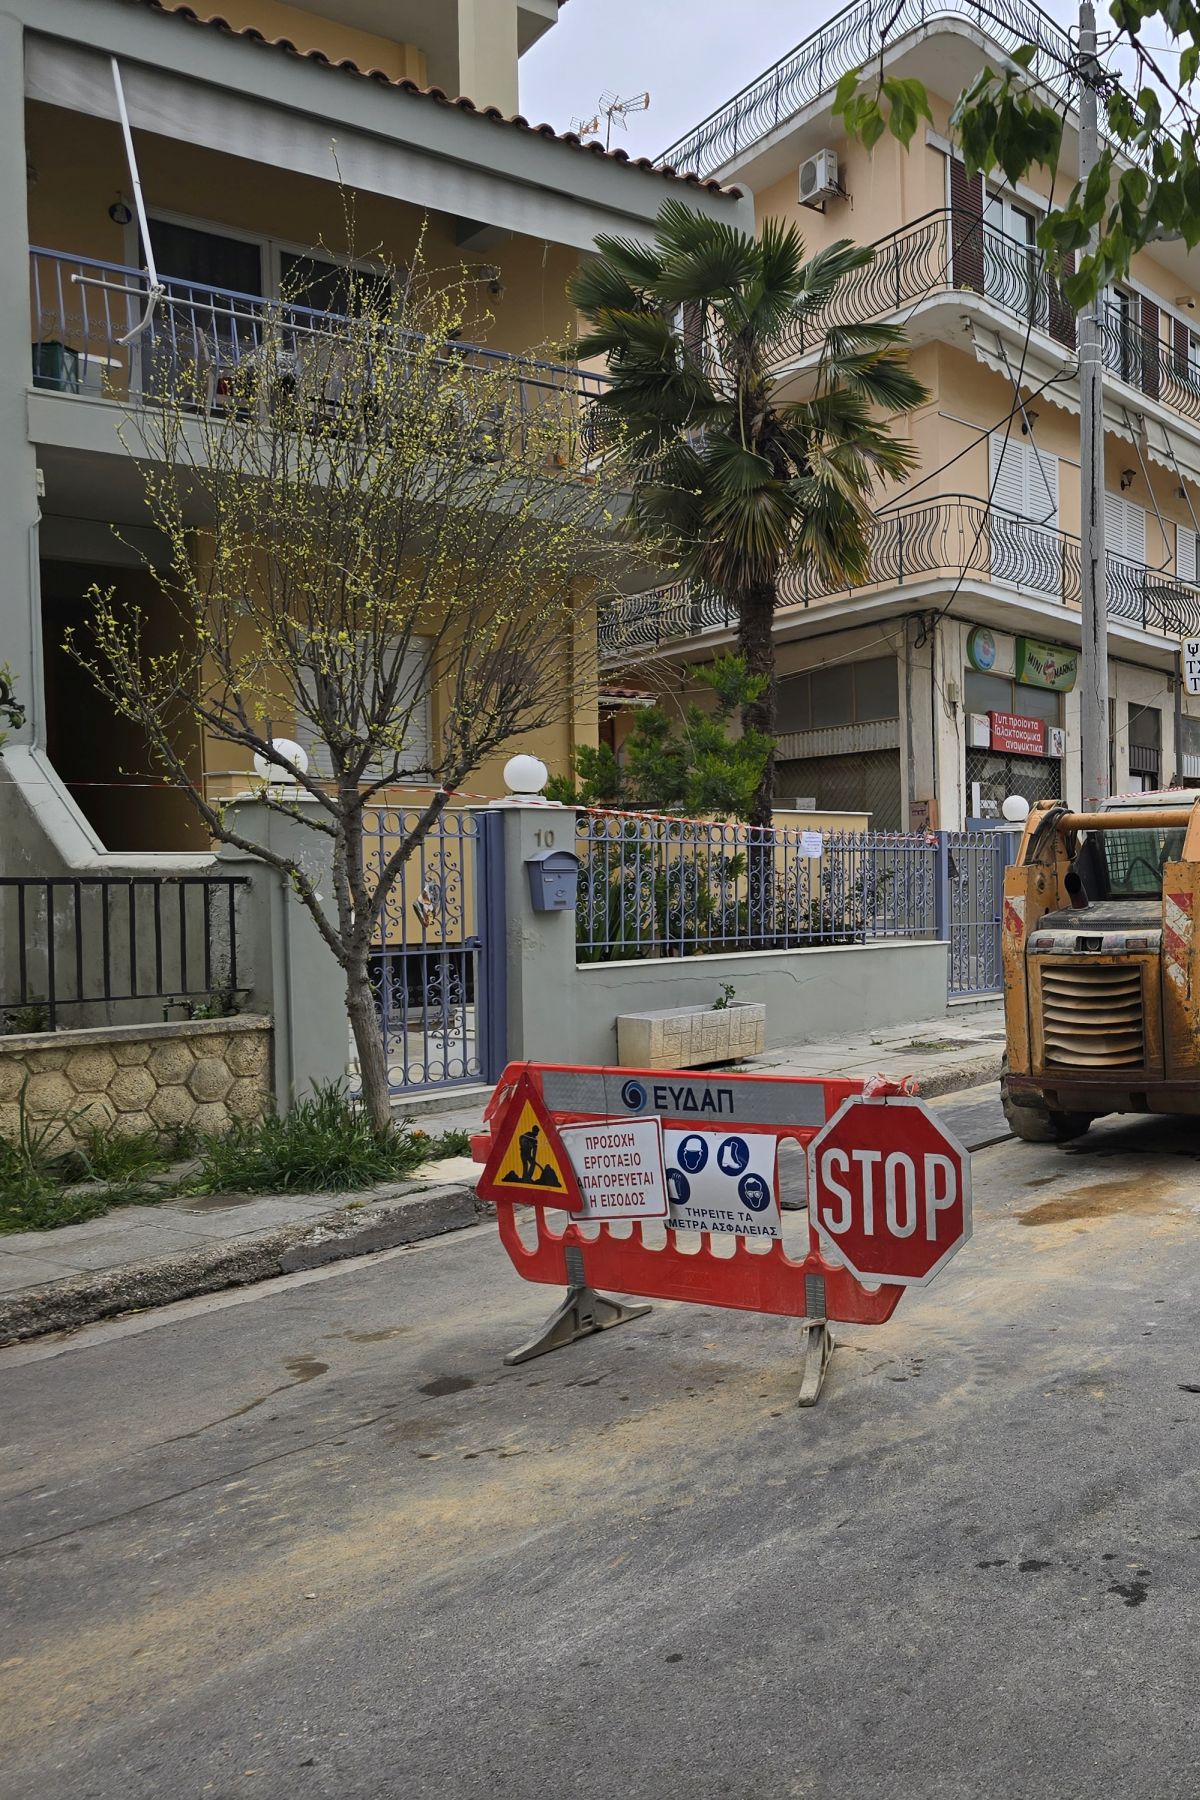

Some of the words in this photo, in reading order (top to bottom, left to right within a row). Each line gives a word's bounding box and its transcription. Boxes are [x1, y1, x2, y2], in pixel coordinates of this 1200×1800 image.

[1027, 651, 1043, 674] MINI
[534, 829, 554, 848] 10
[653, 1085, 734, 1113] ΕΥΔΑΠ
[585, 1133, 635, 1150] ΠΡΟΣΟΧΗ
[584, 1152, 641, 1170] ΕΡΓΟΤΑΞΙΟ
[577, 1171, 654, 1190] ΑΠΑΓΟΡΕΥΕΤΑΙ
[589, 1194, 597, 1208] Η
[600, 1192, 646, 1208] ΕΙΣΟΔΟΣ
[821, 1148, 957, 1241] STOP
[685, 1207, 734, 1221] ΤΗΡΕΙΤΕ
[738, 1211, 753, 1222] ΤΑ
[668, 1218, 708, 1230] ΜΕΤΡΑ
[712, 1222, 777, 1236] ΑΣΦΑΛΕΙΑΣ
